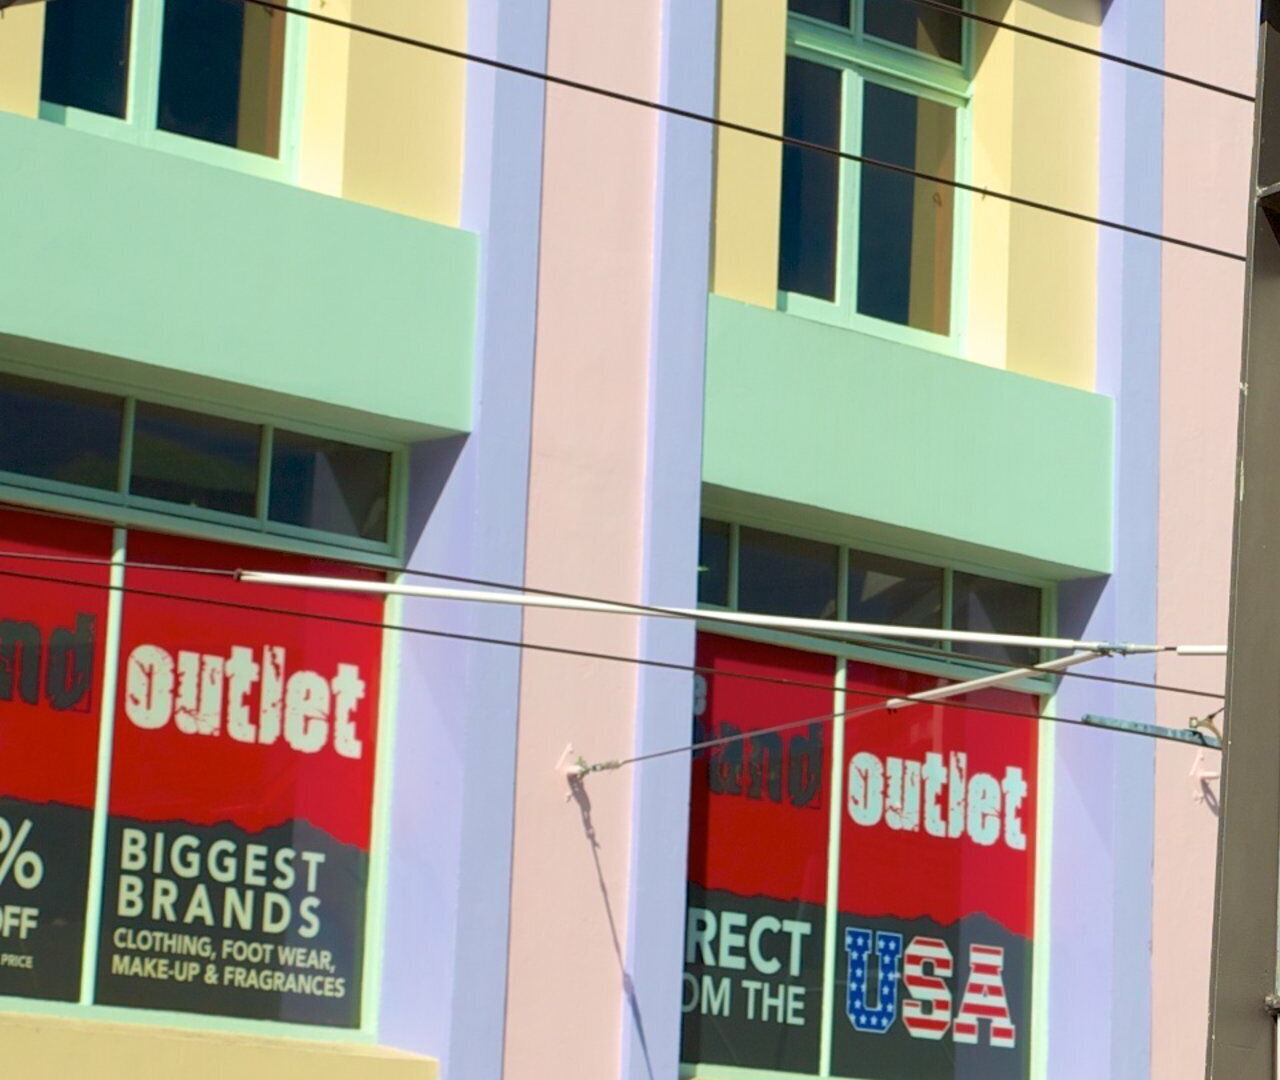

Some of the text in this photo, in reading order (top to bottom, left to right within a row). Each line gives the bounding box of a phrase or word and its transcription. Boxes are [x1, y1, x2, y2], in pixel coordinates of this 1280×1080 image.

[125, 644, 365, 759] outlet
[847, 750, 1027, 851] outlet
[121, 828, 326, 892] BIGGEST
[0, 904, 40, 939] FF
[117, 874, 321, 938] BRANDS
[1, 953, 34, 970] PRICE
[111, 954, 346, 999] MAKE-UP & FRAGRANCES
[113, 927, 336, 974] CLOTHING, FOOT WEAR,
[741, 979, 806, 1026] THE
[845, 926, 1016, 1048] USA
